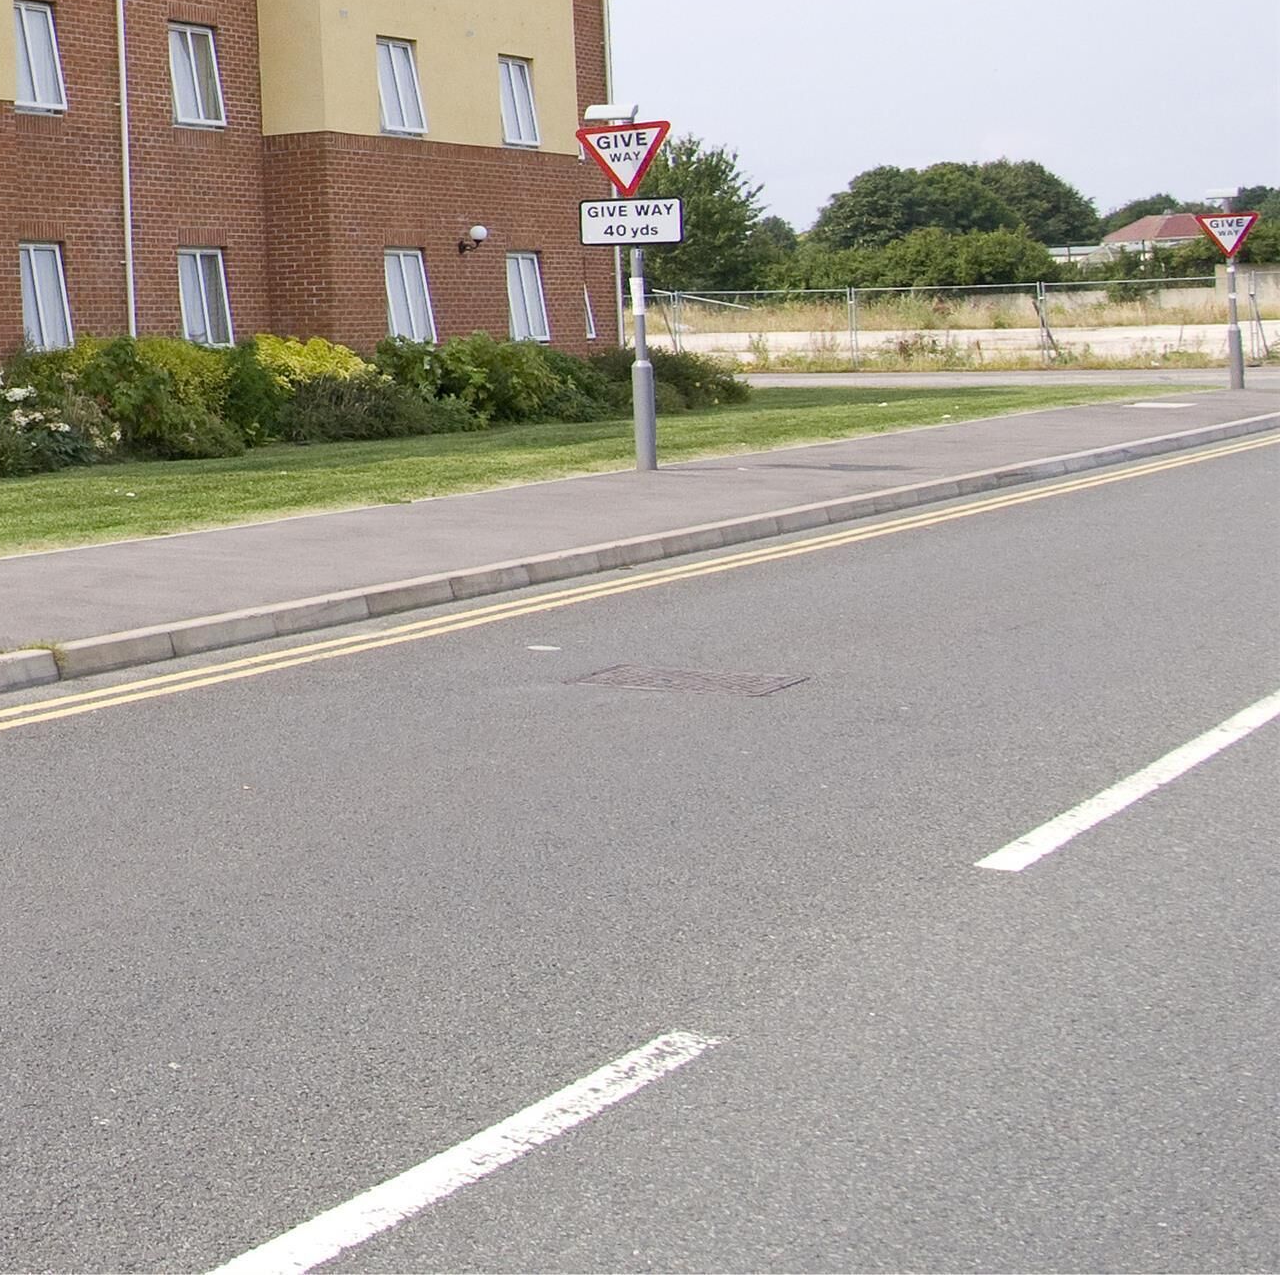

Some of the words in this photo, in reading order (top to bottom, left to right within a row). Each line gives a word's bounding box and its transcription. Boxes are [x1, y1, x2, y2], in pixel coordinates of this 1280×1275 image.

[596, 132, 648, 150] GIVE
[609, 151, 641, 163] WAY
[587, 205, 628, 218] GIVE
[635, 203, 674, 217] WAY
[1209, 218, 1245, 229] GIVE
[604, 224, 627, 237] 40
[631, 224, 659, 238] yds
[1218, 229, 1240, 237] WAY
